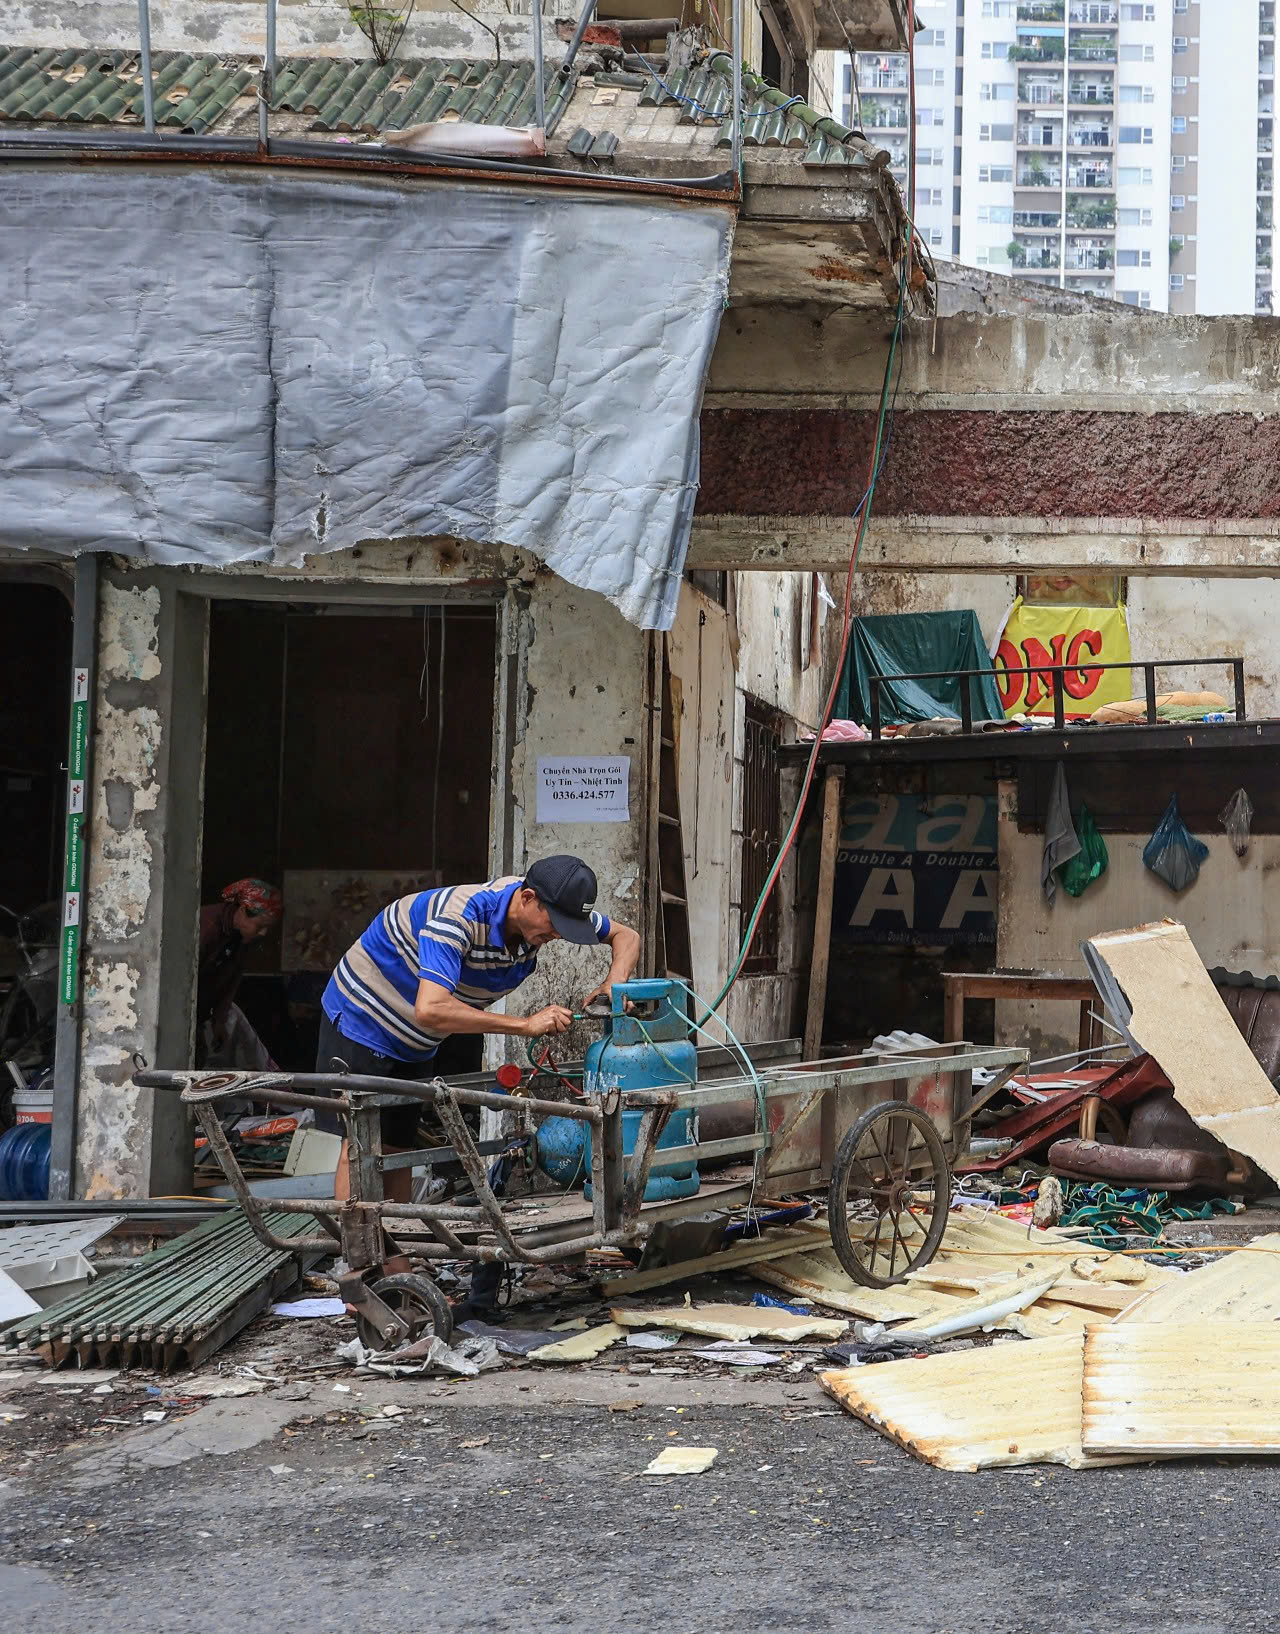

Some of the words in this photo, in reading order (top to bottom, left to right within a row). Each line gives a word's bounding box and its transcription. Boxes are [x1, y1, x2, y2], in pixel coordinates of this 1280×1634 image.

[543, 766, 570, 776] Chuyển
[572, 766, 587, 775] Nhà
[589, 766, 606, 775] Trọn
[545, 778, 557, 788] Uy
[581, 777, 602, 787] Nhiệt
[604, 777, 623, 786] Tình
[552, 790, 616, 801] 0336.424.577
[837, 852, 896, 866] Double
[901, 854, 914, 866] A
[925, 854, 984, 867] Double
[848, 868, 915, 929] A
